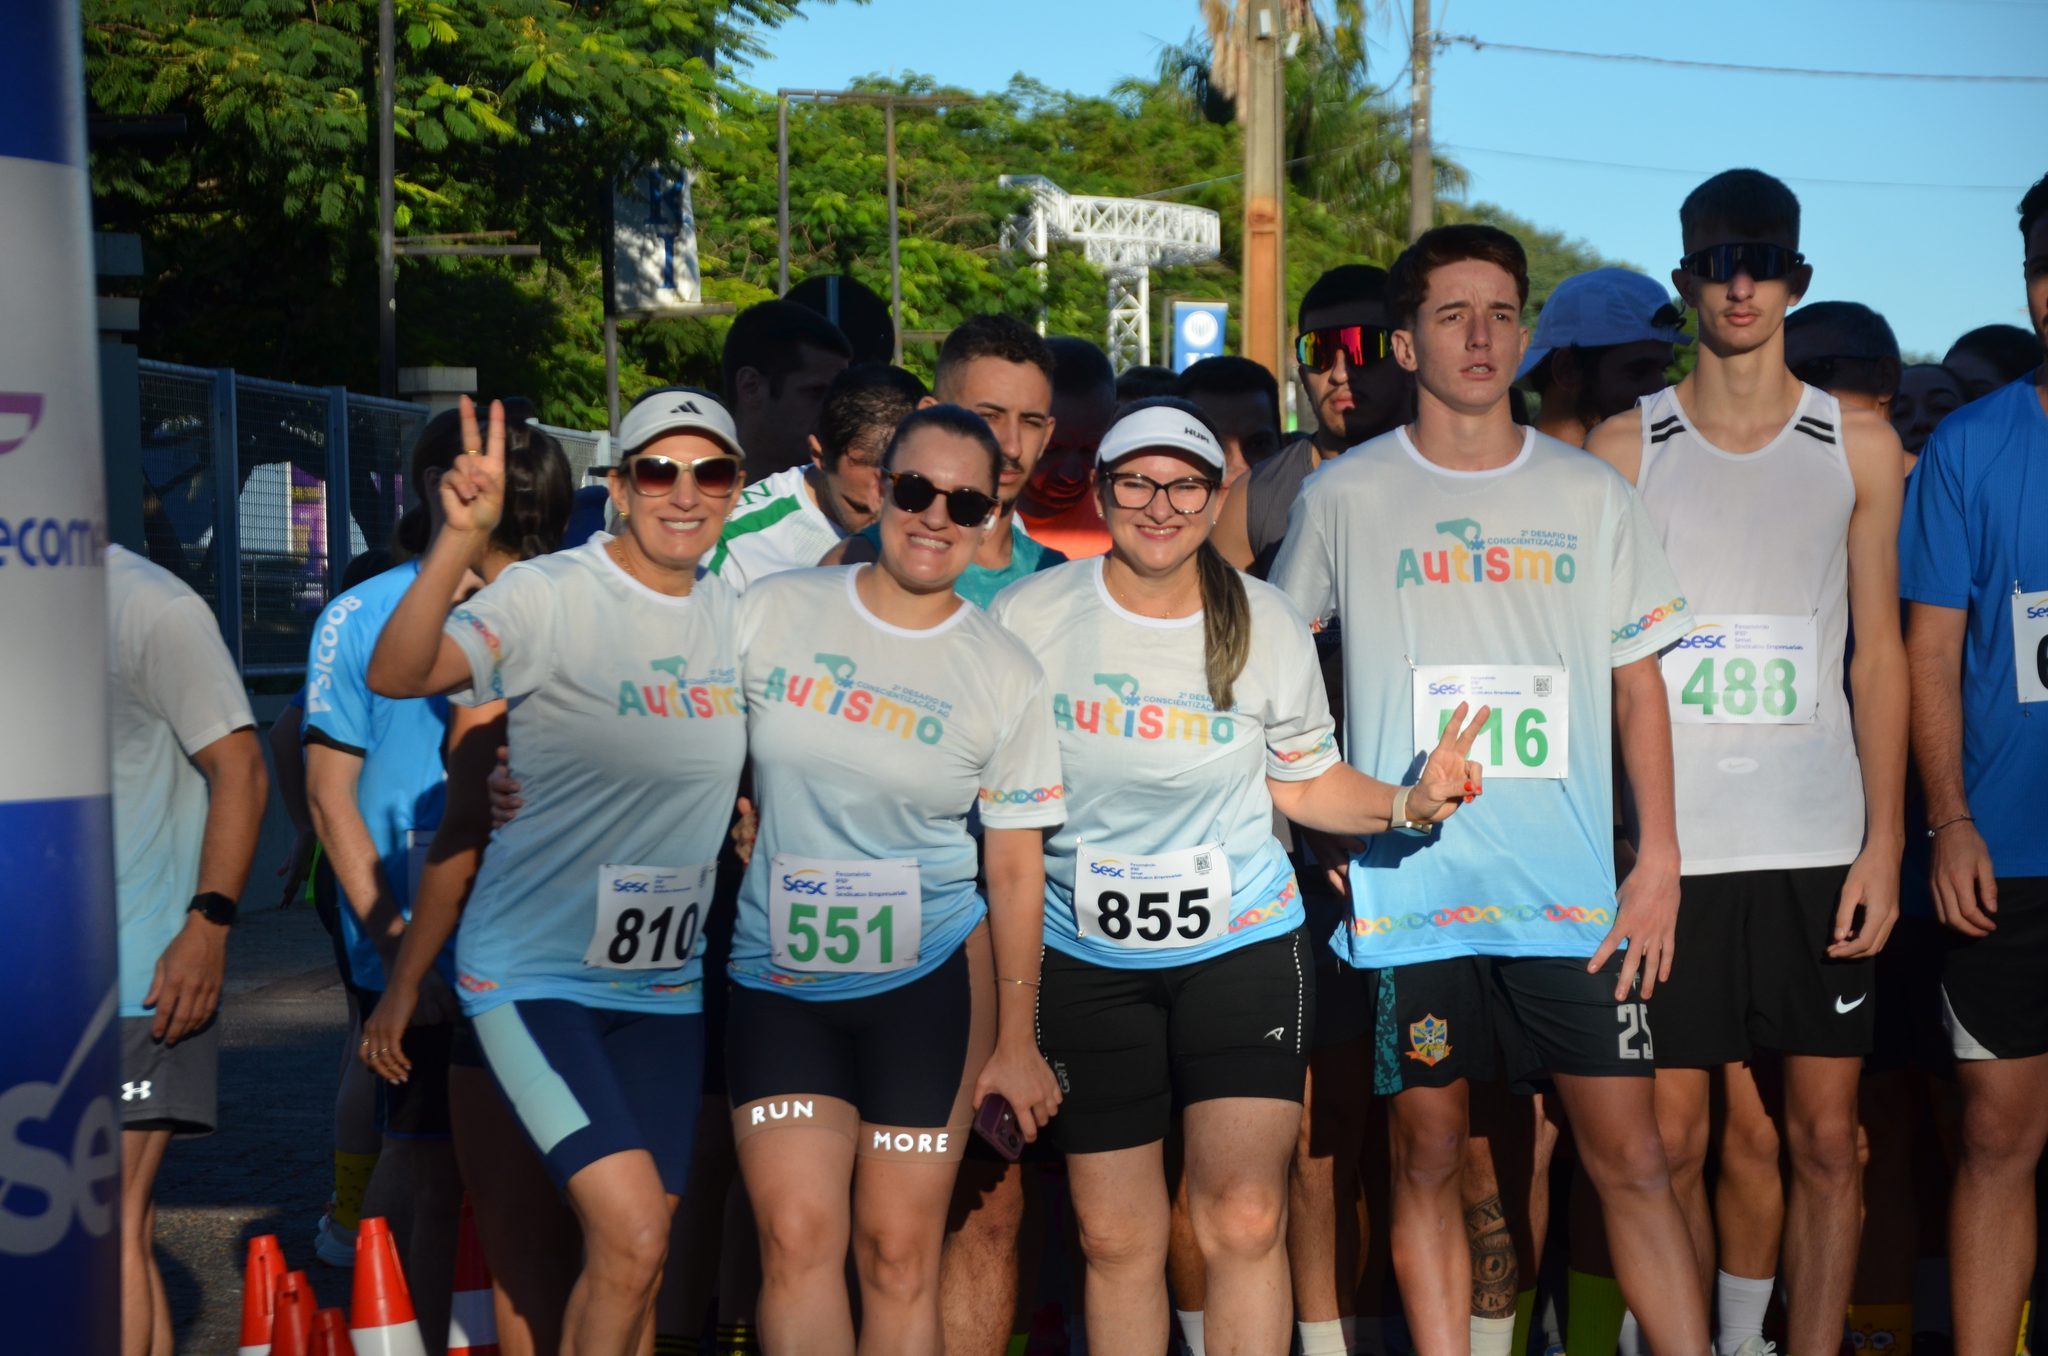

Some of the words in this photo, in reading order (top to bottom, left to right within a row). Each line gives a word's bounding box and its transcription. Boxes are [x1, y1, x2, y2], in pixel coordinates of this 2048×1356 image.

[1531, 530, 1565, 540] DESAFIO
[1567, 533, 1577, 542] EM
[1396, 544, 1576, 588] Autismo
[1189, 693, 1213, 702] DESA
[1428, 683, 1465, 695] Sesc
[1682, 657, 1798, 717] 488
[764, 666, 944, 745] Autismo
[1143, 696, 1214, 711] CONSCIENTIZAÇ
[1054, 693, 1235, 745] Autismo
[1090, 862, 1125, 878] Sesc
[613, 879, 650, 893] Sesc
[783, 874, 827, 896] Sesc
[1097, 887, 1211, 941] 855
[608, 902, 699, 964] 810
[787, 902, 893, 964] 551
[752, 1100, 814, 1126] RUN
[873, 1130, 949, 1153] MORE
